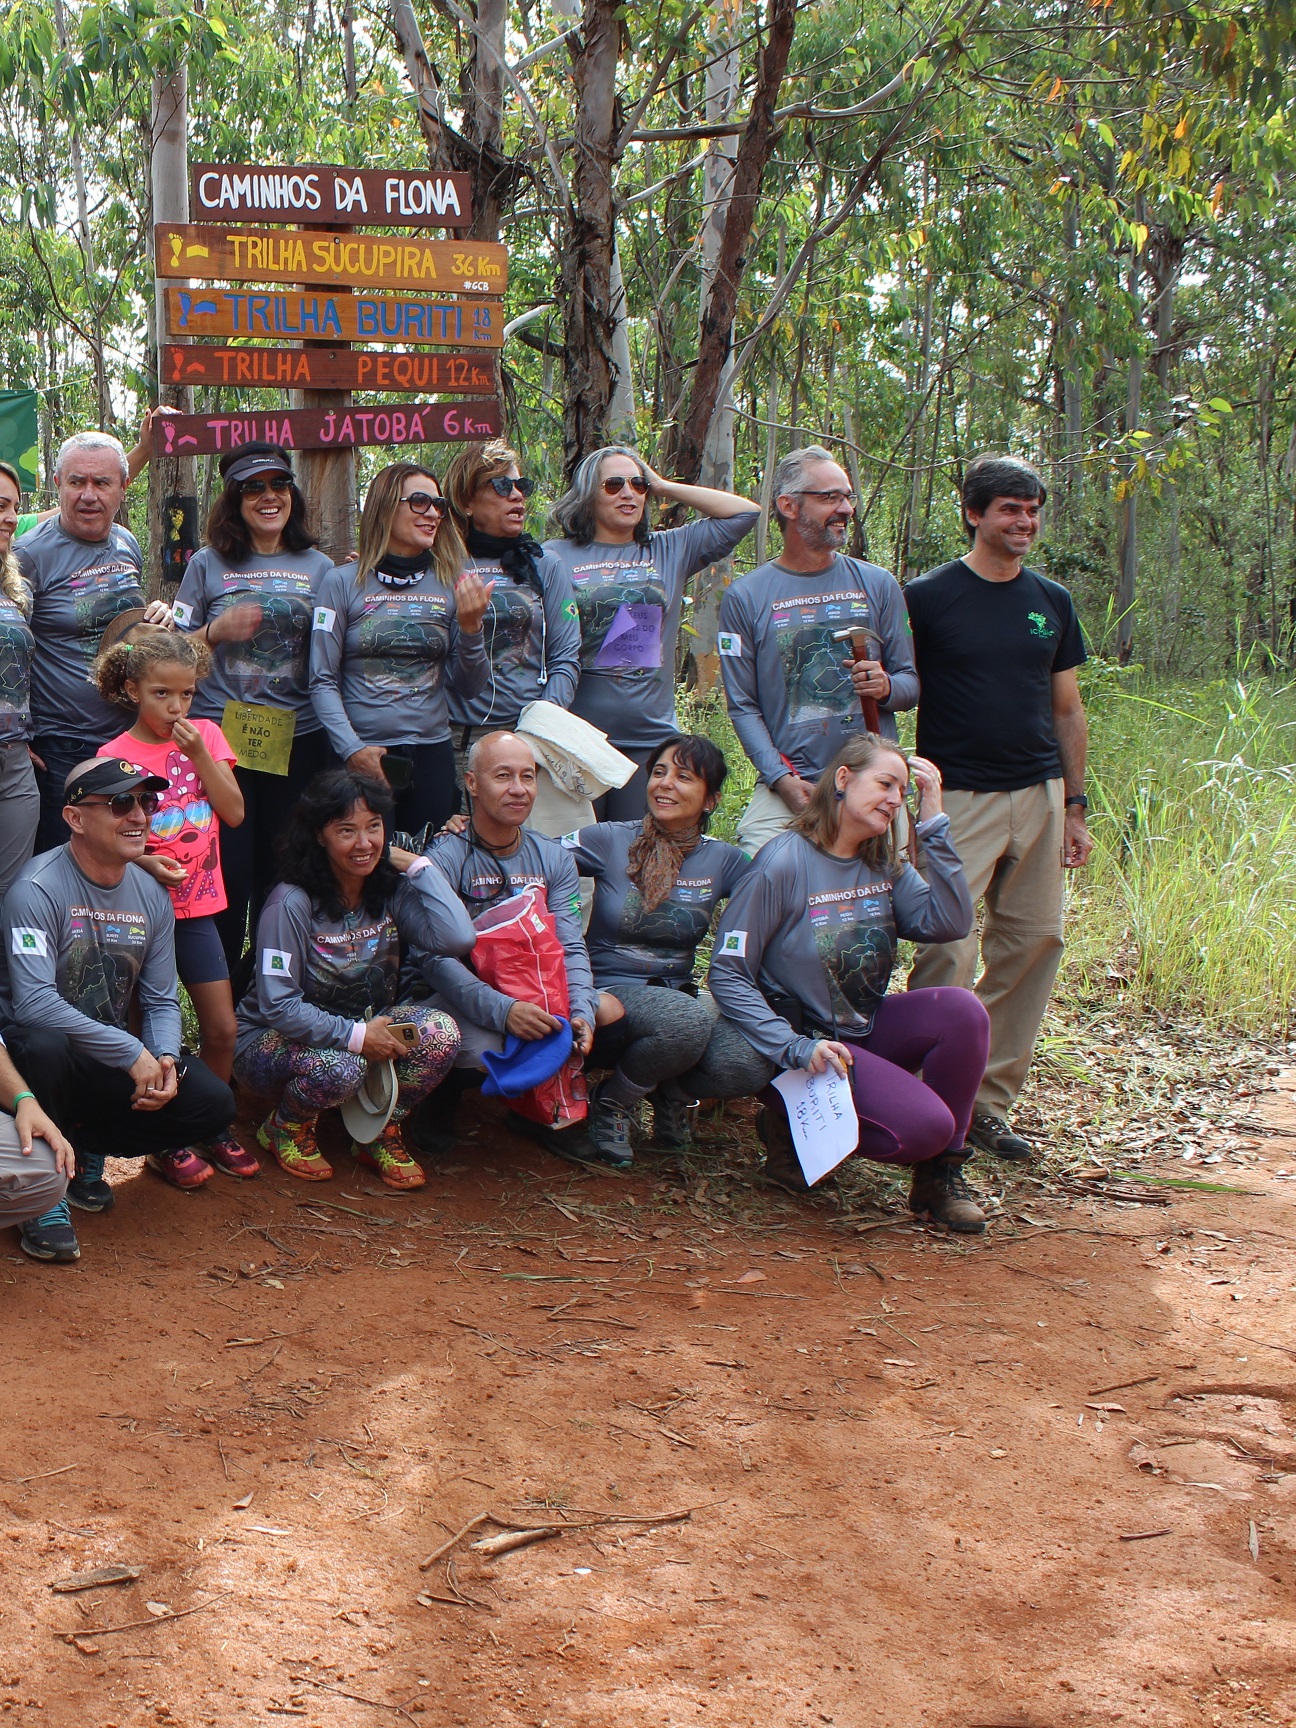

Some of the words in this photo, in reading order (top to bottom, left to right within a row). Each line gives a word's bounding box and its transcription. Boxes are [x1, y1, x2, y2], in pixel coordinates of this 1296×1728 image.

[198, 172, 322, 211] CAMINHOS
[334, 175, 368, 213] DA
[385, 177, 462, 217] FLONA
[226, 234, 307, 272] TRILHA
[311, 240, 438, 279] SUCUPIRA
[450, 252, 475, 277] 36
[463, 280, 490, 291] #GCB
[223, 293, 342, 334] TRILHA
[357, 300, 462, 339] BURITI
[472, 307, 491, 328] 18
[214, 351, 311, 382] TRILHA
[357, 355, 438, 387] PEQUI
[206, 418, 295, 449] TRILHA
[319, 406, 432, 442] JATOBÁ
[443, 409, 461, 435] 6
[464, 418, 494, 435] Km
[573, 561, 620, 573] CAMINHOS
[223, 571, 269, 580] CAMINHOS
[283, 572, 309, 581] FLONA
[365, 595, 407, 603] CAMINHOS
[420, 596, 446, 604] FLONA
[772, 596, 821, 611] CAMINHOS
[822, 594, 836, 603] DA
[835, 592, 866, 601] FLONA
[614, 643, 644, 652] CORPO
[235, 711, 284, 726] LIBERDADE
[242, 723, 248, 734] É
[249, 727, 271, 738] NÃO
[248, 738, 263, 748] TER
[239, 749, 267, 760] MEDO
[510, 876, 522, 885] DA
[676, 879, 688, 887] DA
[688, 878, 712, 887] FLONA
[808, 889, 857, 906] CAMINHOS
[857, 887, 871, 897] DA
[116, 913, 145, 924] FLONA
[363, 927, 377, 938] DA
[826, 1069, 843, 1120] TRILHA
[805, 1076, 827, 1132] BURITI
